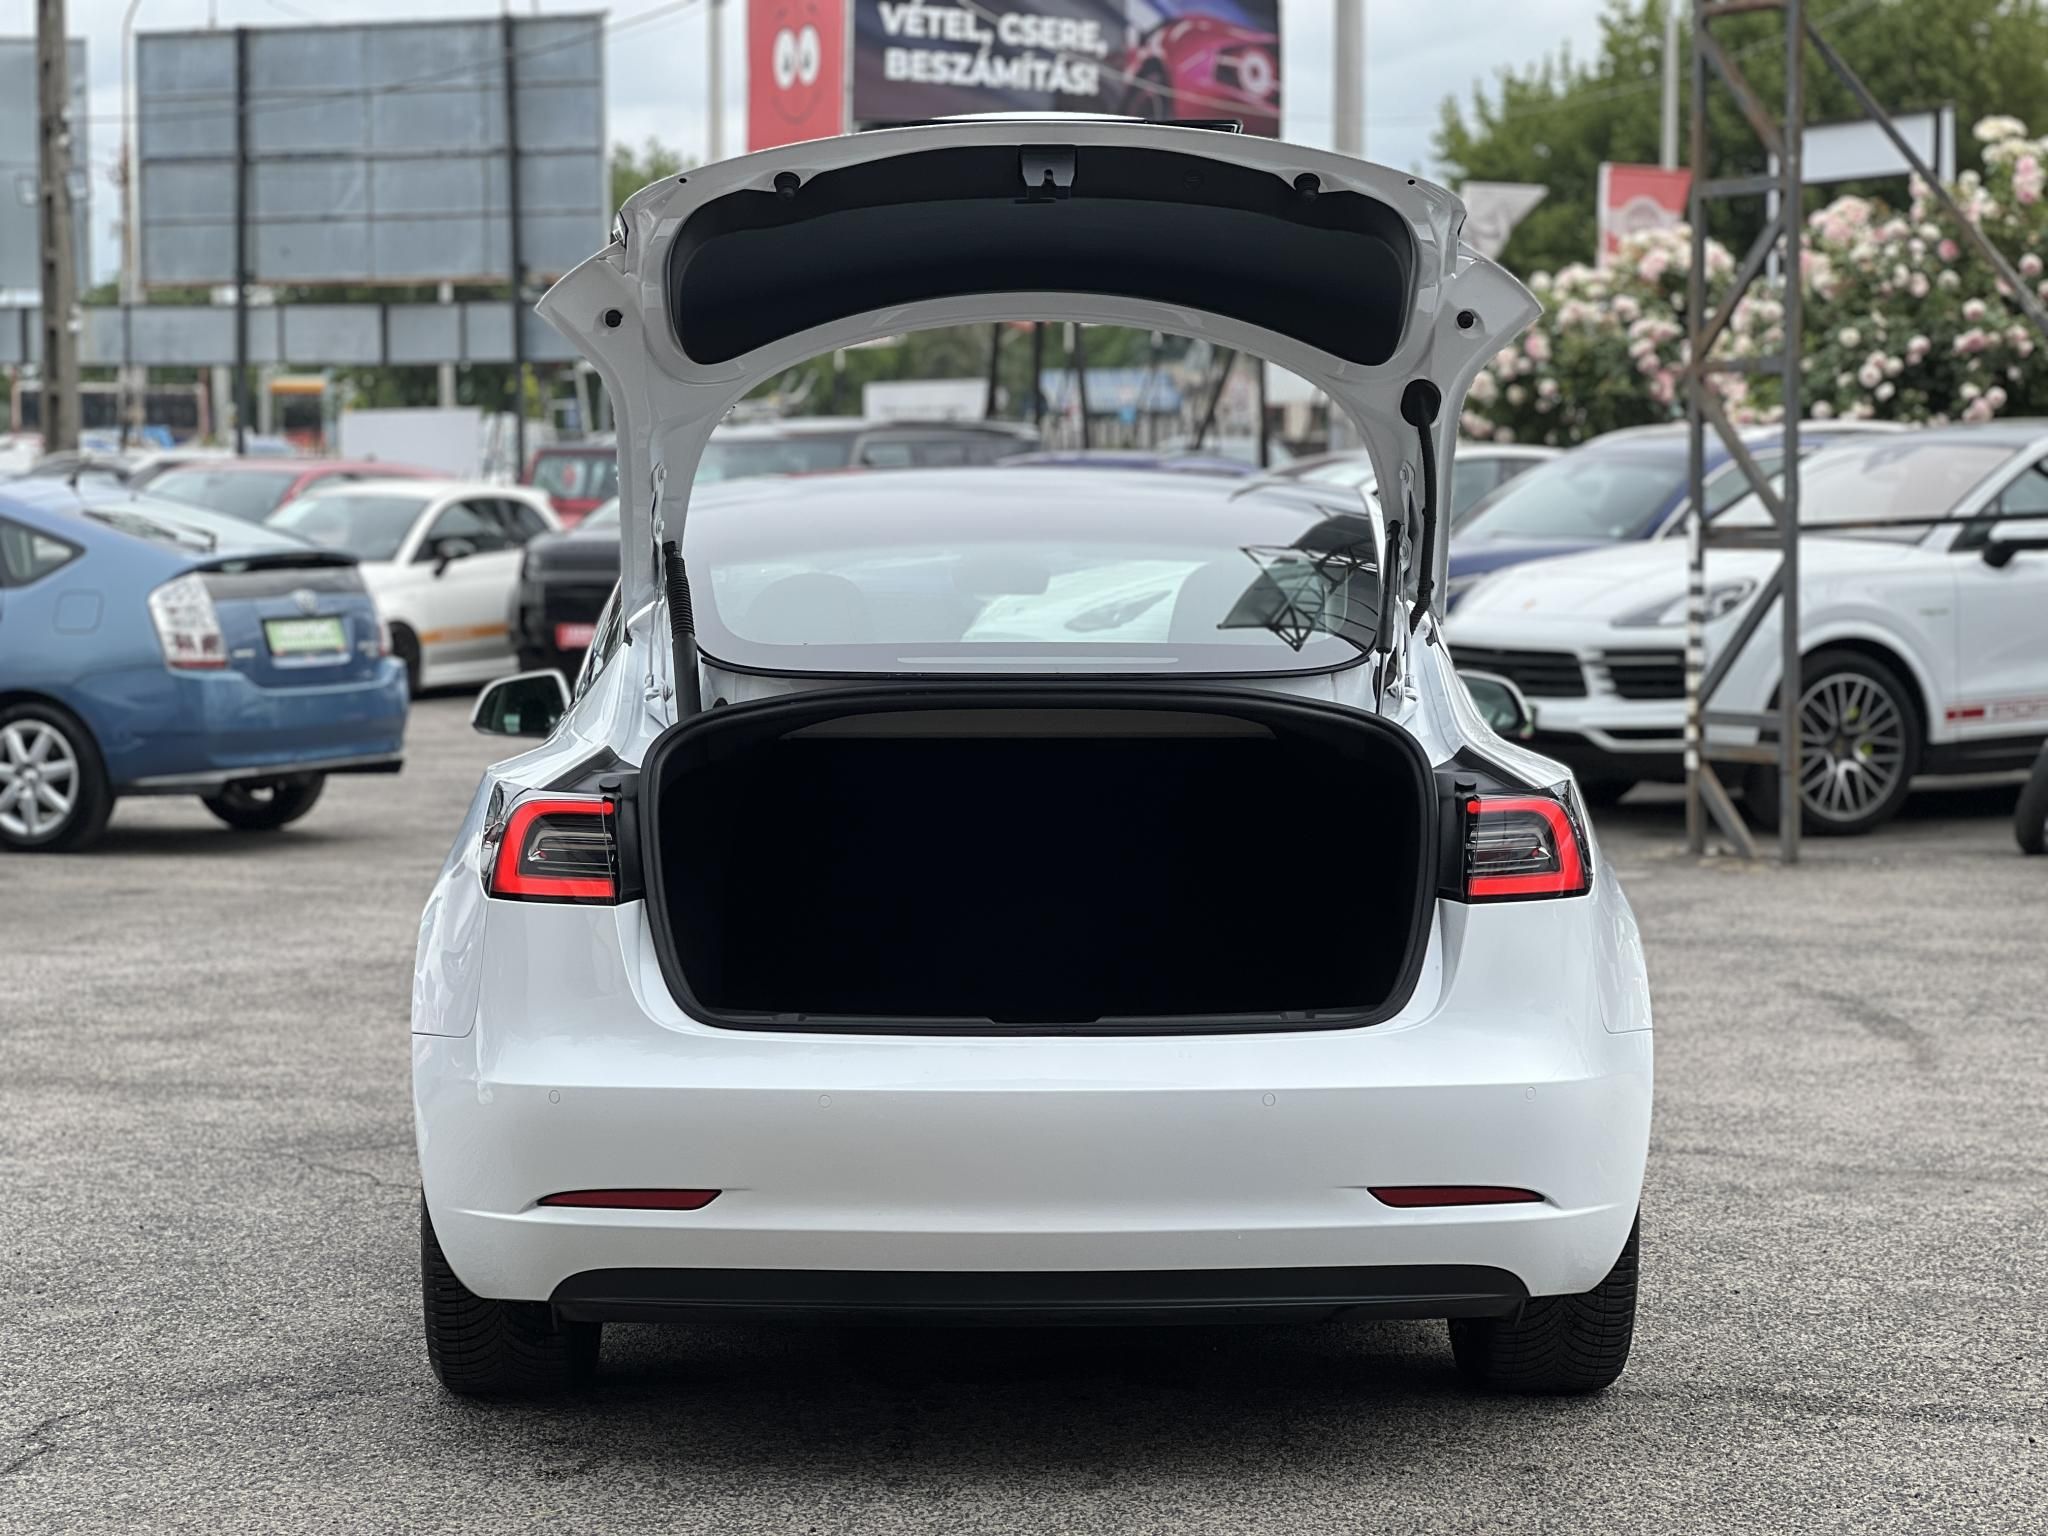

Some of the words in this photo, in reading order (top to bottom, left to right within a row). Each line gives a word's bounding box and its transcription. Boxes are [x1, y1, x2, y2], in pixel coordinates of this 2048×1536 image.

[878, 0, 994, 43] VÉTEL,
[997, 12, 1108, 58] CSERE,
[884, 46, 1100, 96] BESZÁMÍTÁS!
